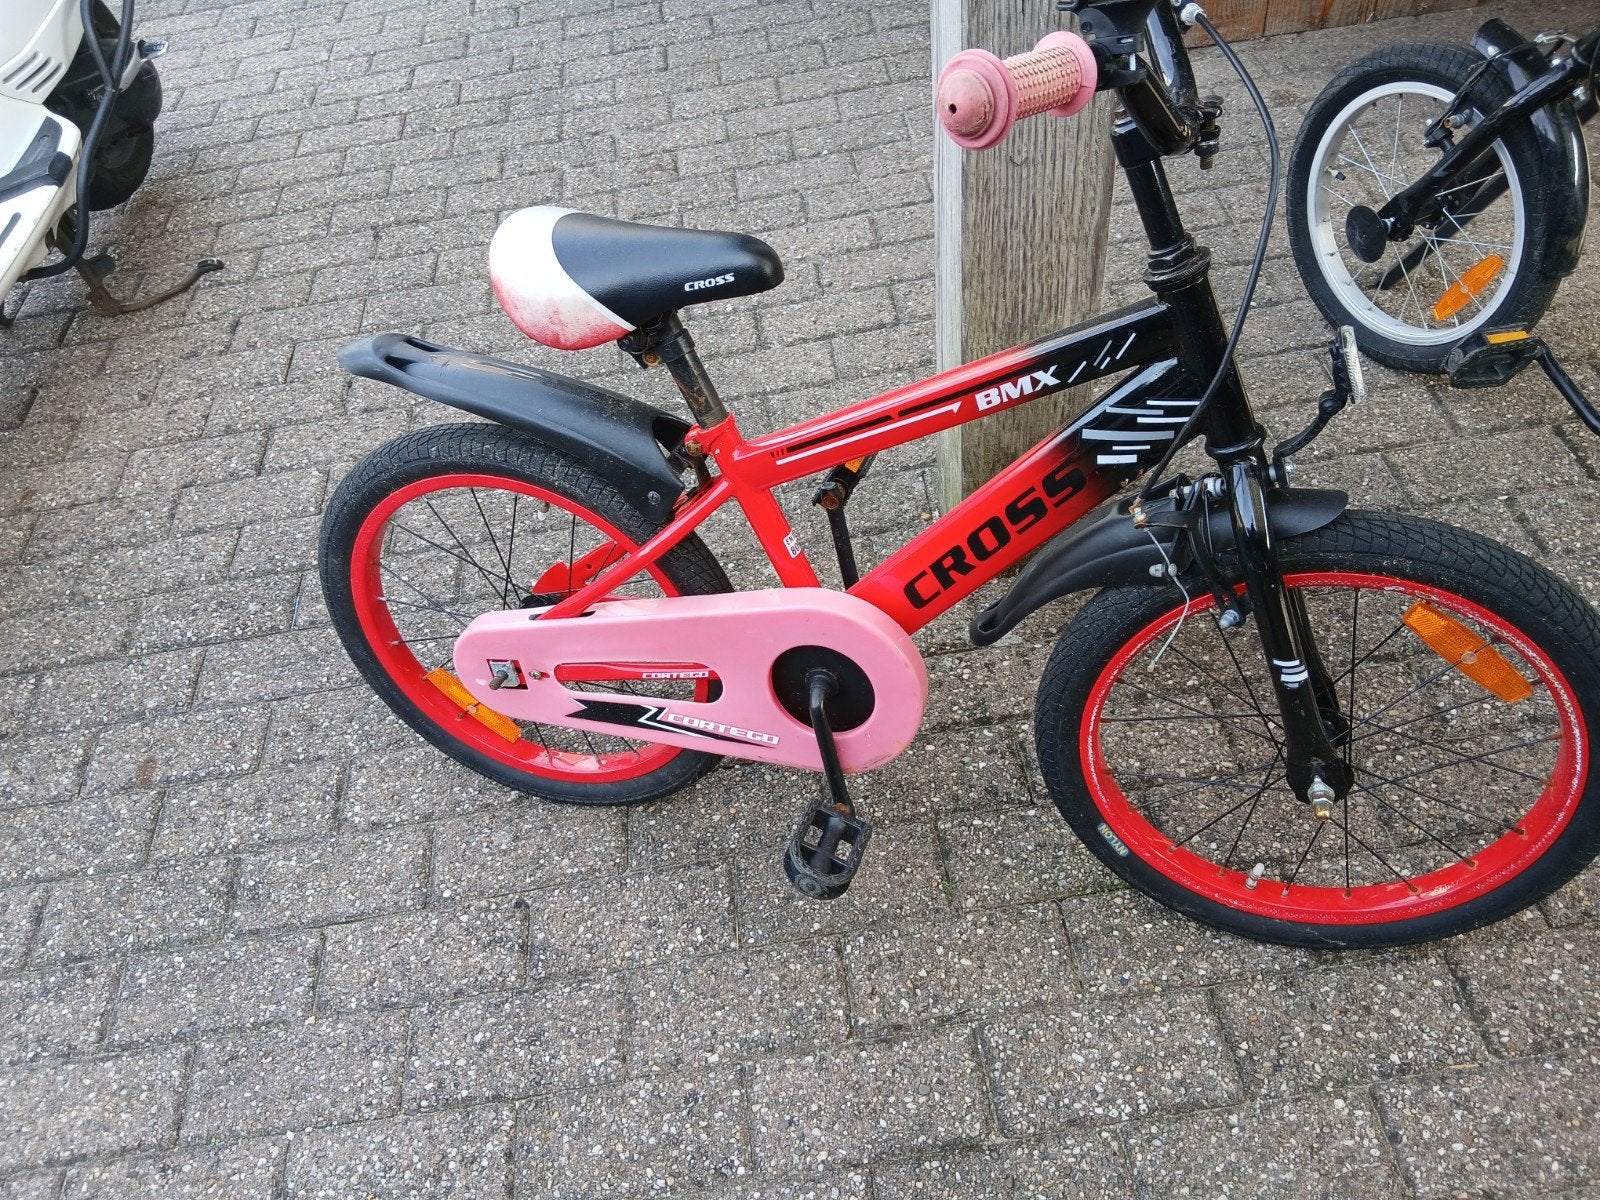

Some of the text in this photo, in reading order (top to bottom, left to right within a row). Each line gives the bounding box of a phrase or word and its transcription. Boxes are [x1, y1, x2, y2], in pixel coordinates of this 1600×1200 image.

[684, 272, 735, 291] CROSS
[974, 364, 1061, 411] BMX
[903, 457, 1088, 609] CROSS
[642, 671, 709, 679] CORTEGO
[667, 713, 780, 745] CORTEGO
[1098, 822, 1129, 856] NYLON
